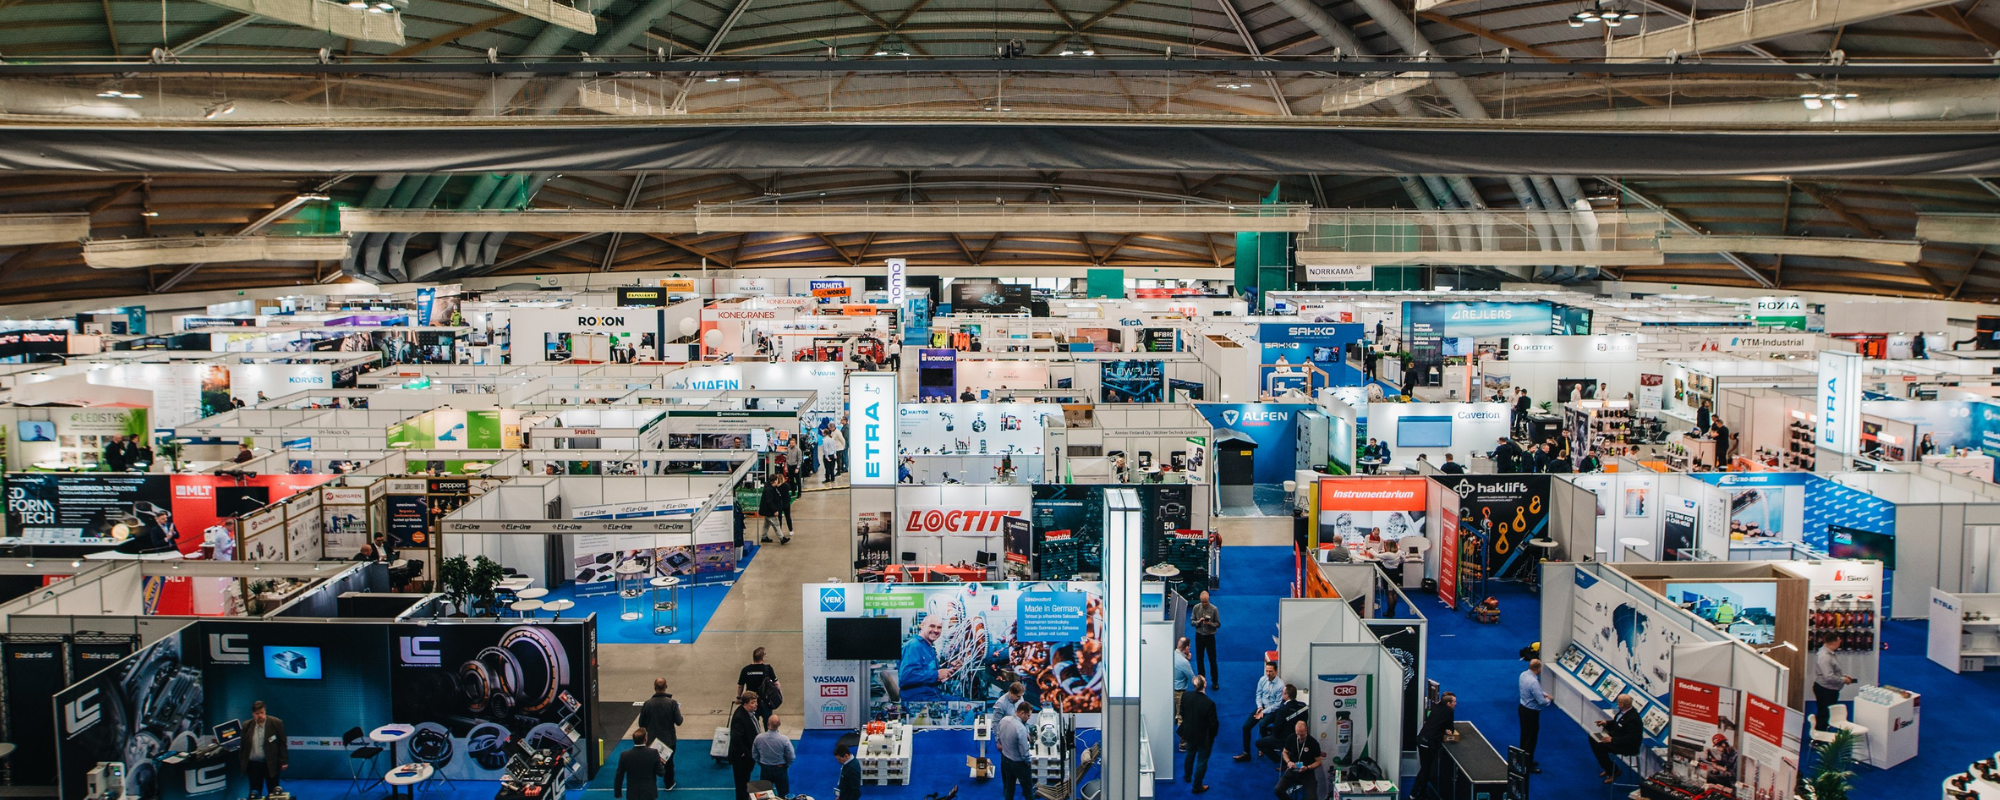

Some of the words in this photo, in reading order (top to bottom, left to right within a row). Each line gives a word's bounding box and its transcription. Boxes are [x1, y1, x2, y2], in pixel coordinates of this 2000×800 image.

[1462, 310, 1512, 319] REJLERS
[578, 317, 624, 326] ROXON
[1119, 318, 1143, 326] TECA
[1105, 368, 1159, 376] FLOWPLUS
[692, 380, 738, 390] VIAFIN
[1826, 378, 1837, 443] ETRA
[1243, 412, 1288, 420] ALFEN
[865, 402, 880, 477] ETRA
[187, 486, 212, 495] MLT
[1478, 482, 1528, 493] haklift
[1333, 490, 1414, 498] Instrumentarium
[9, 499, 56, 512] FORM
[20, 512, 55, 524] TECH
[906, 510, 1022, 532] LOCTIT
[1052, 604, 1080, 613] Germany
[1933, 598, 1953, 611] ETRA
[209, 633, 249, 661] LC
[399, 637, 441, 664] LC
[822, 686, 847, 696] KEB
[1679, 682, 1702, 692] fischer
[1750, 698, 1770, 710] fischer
